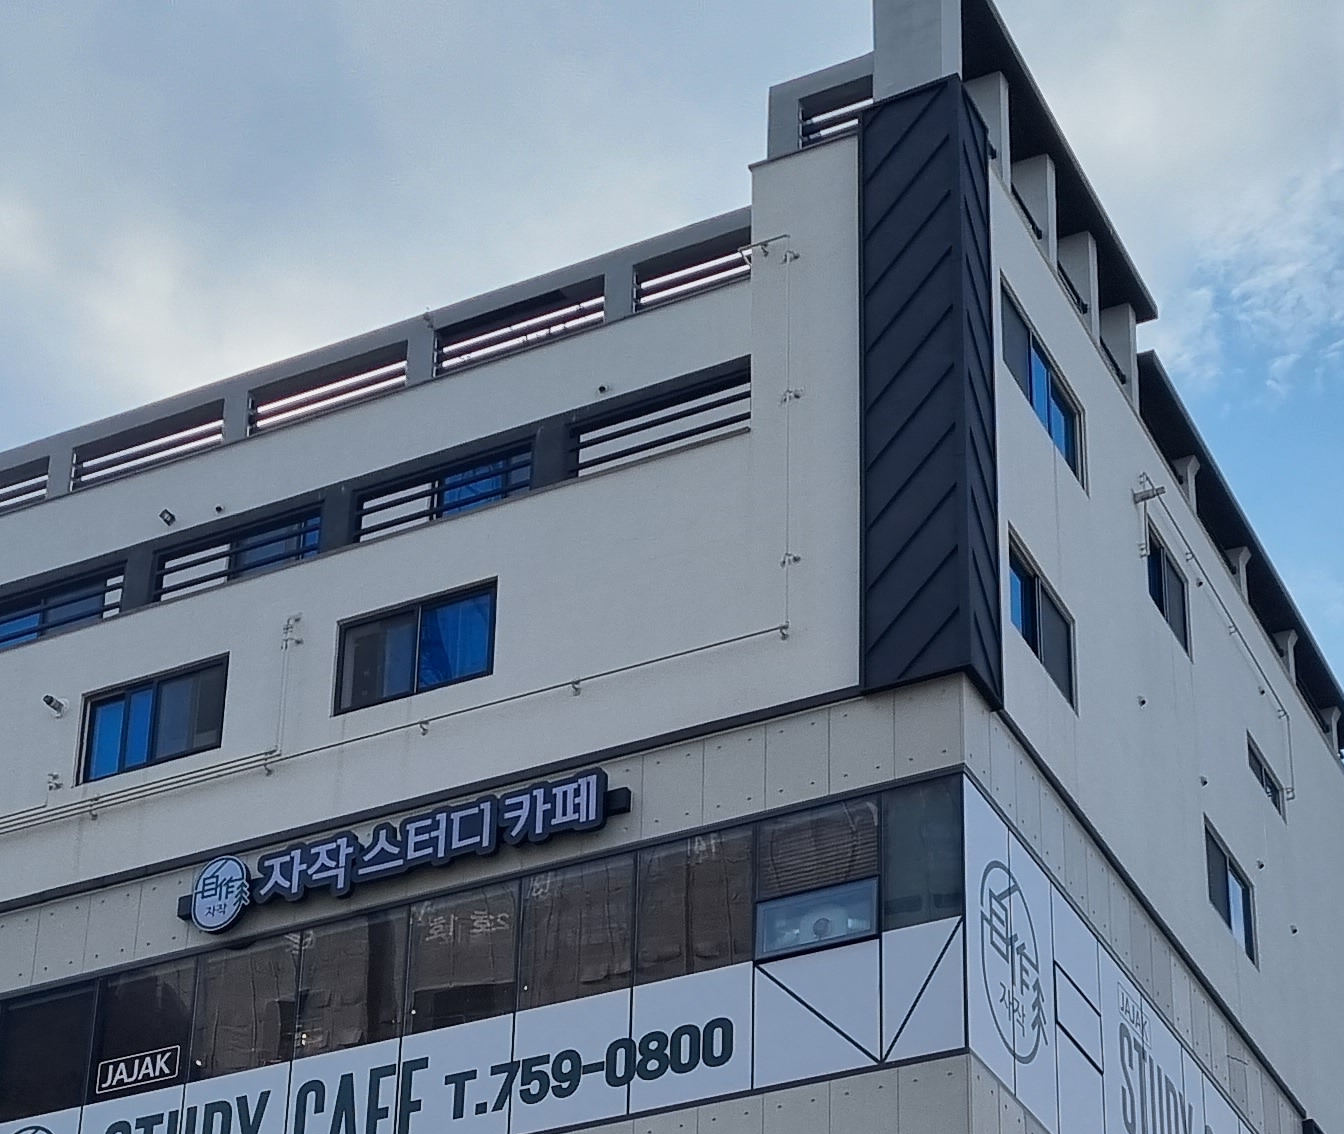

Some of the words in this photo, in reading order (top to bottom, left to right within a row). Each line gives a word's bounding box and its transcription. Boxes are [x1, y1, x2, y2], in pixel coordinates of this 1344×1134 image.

[259, 836, 353, 896] 자작
[358, 801, 492, 876] 스터디
[503, 774, 598, 839] 카페
[101, 1051, 173, 1088] JAJAK
[444, 1016, 734, 1120] T.759-0800
